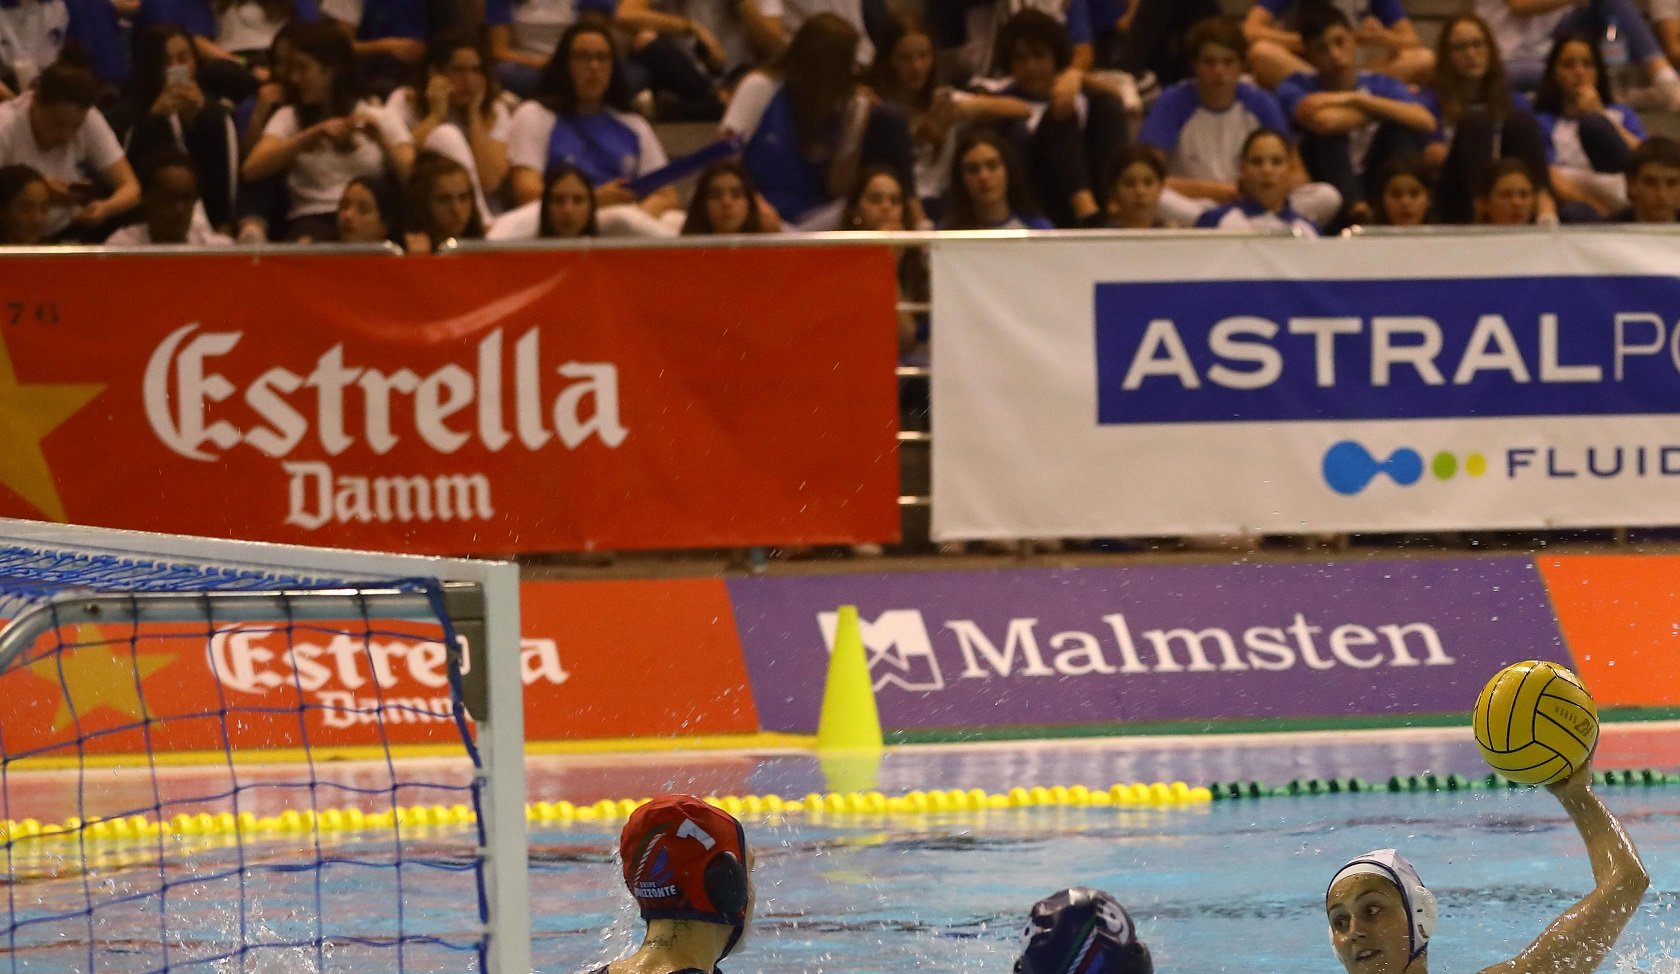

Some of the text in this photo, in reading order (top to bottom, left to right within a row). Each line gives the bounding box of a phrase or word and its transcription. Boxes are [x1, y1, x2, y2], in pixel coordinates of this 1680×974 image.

[142, 321, 630, 462] Estrella
[282, 459, 495, 531] Damm
[205, 622, 571, 694] Estrea
[944, 612, 1457, 679] Malmsten
[676, 818, 716, 850] 1
